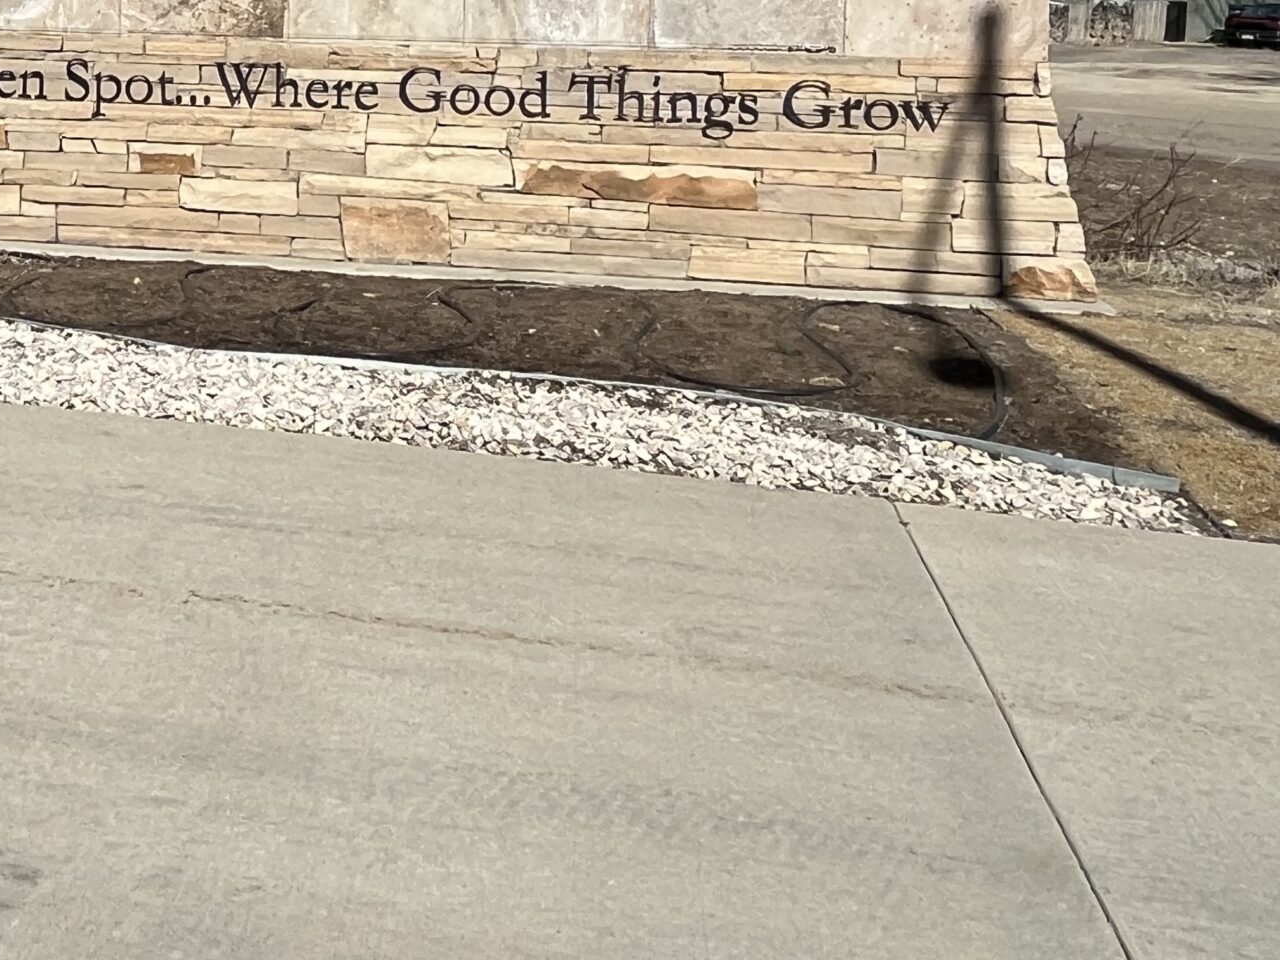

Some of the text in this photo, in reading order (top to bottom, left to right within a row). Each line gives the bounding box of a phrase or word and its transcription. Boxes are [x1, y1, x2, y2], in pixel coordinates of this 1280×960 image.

[399, 67, 550, 120] Good
[567, 67, 759, 140] Things
[783, 79, 952, 134] Grow
